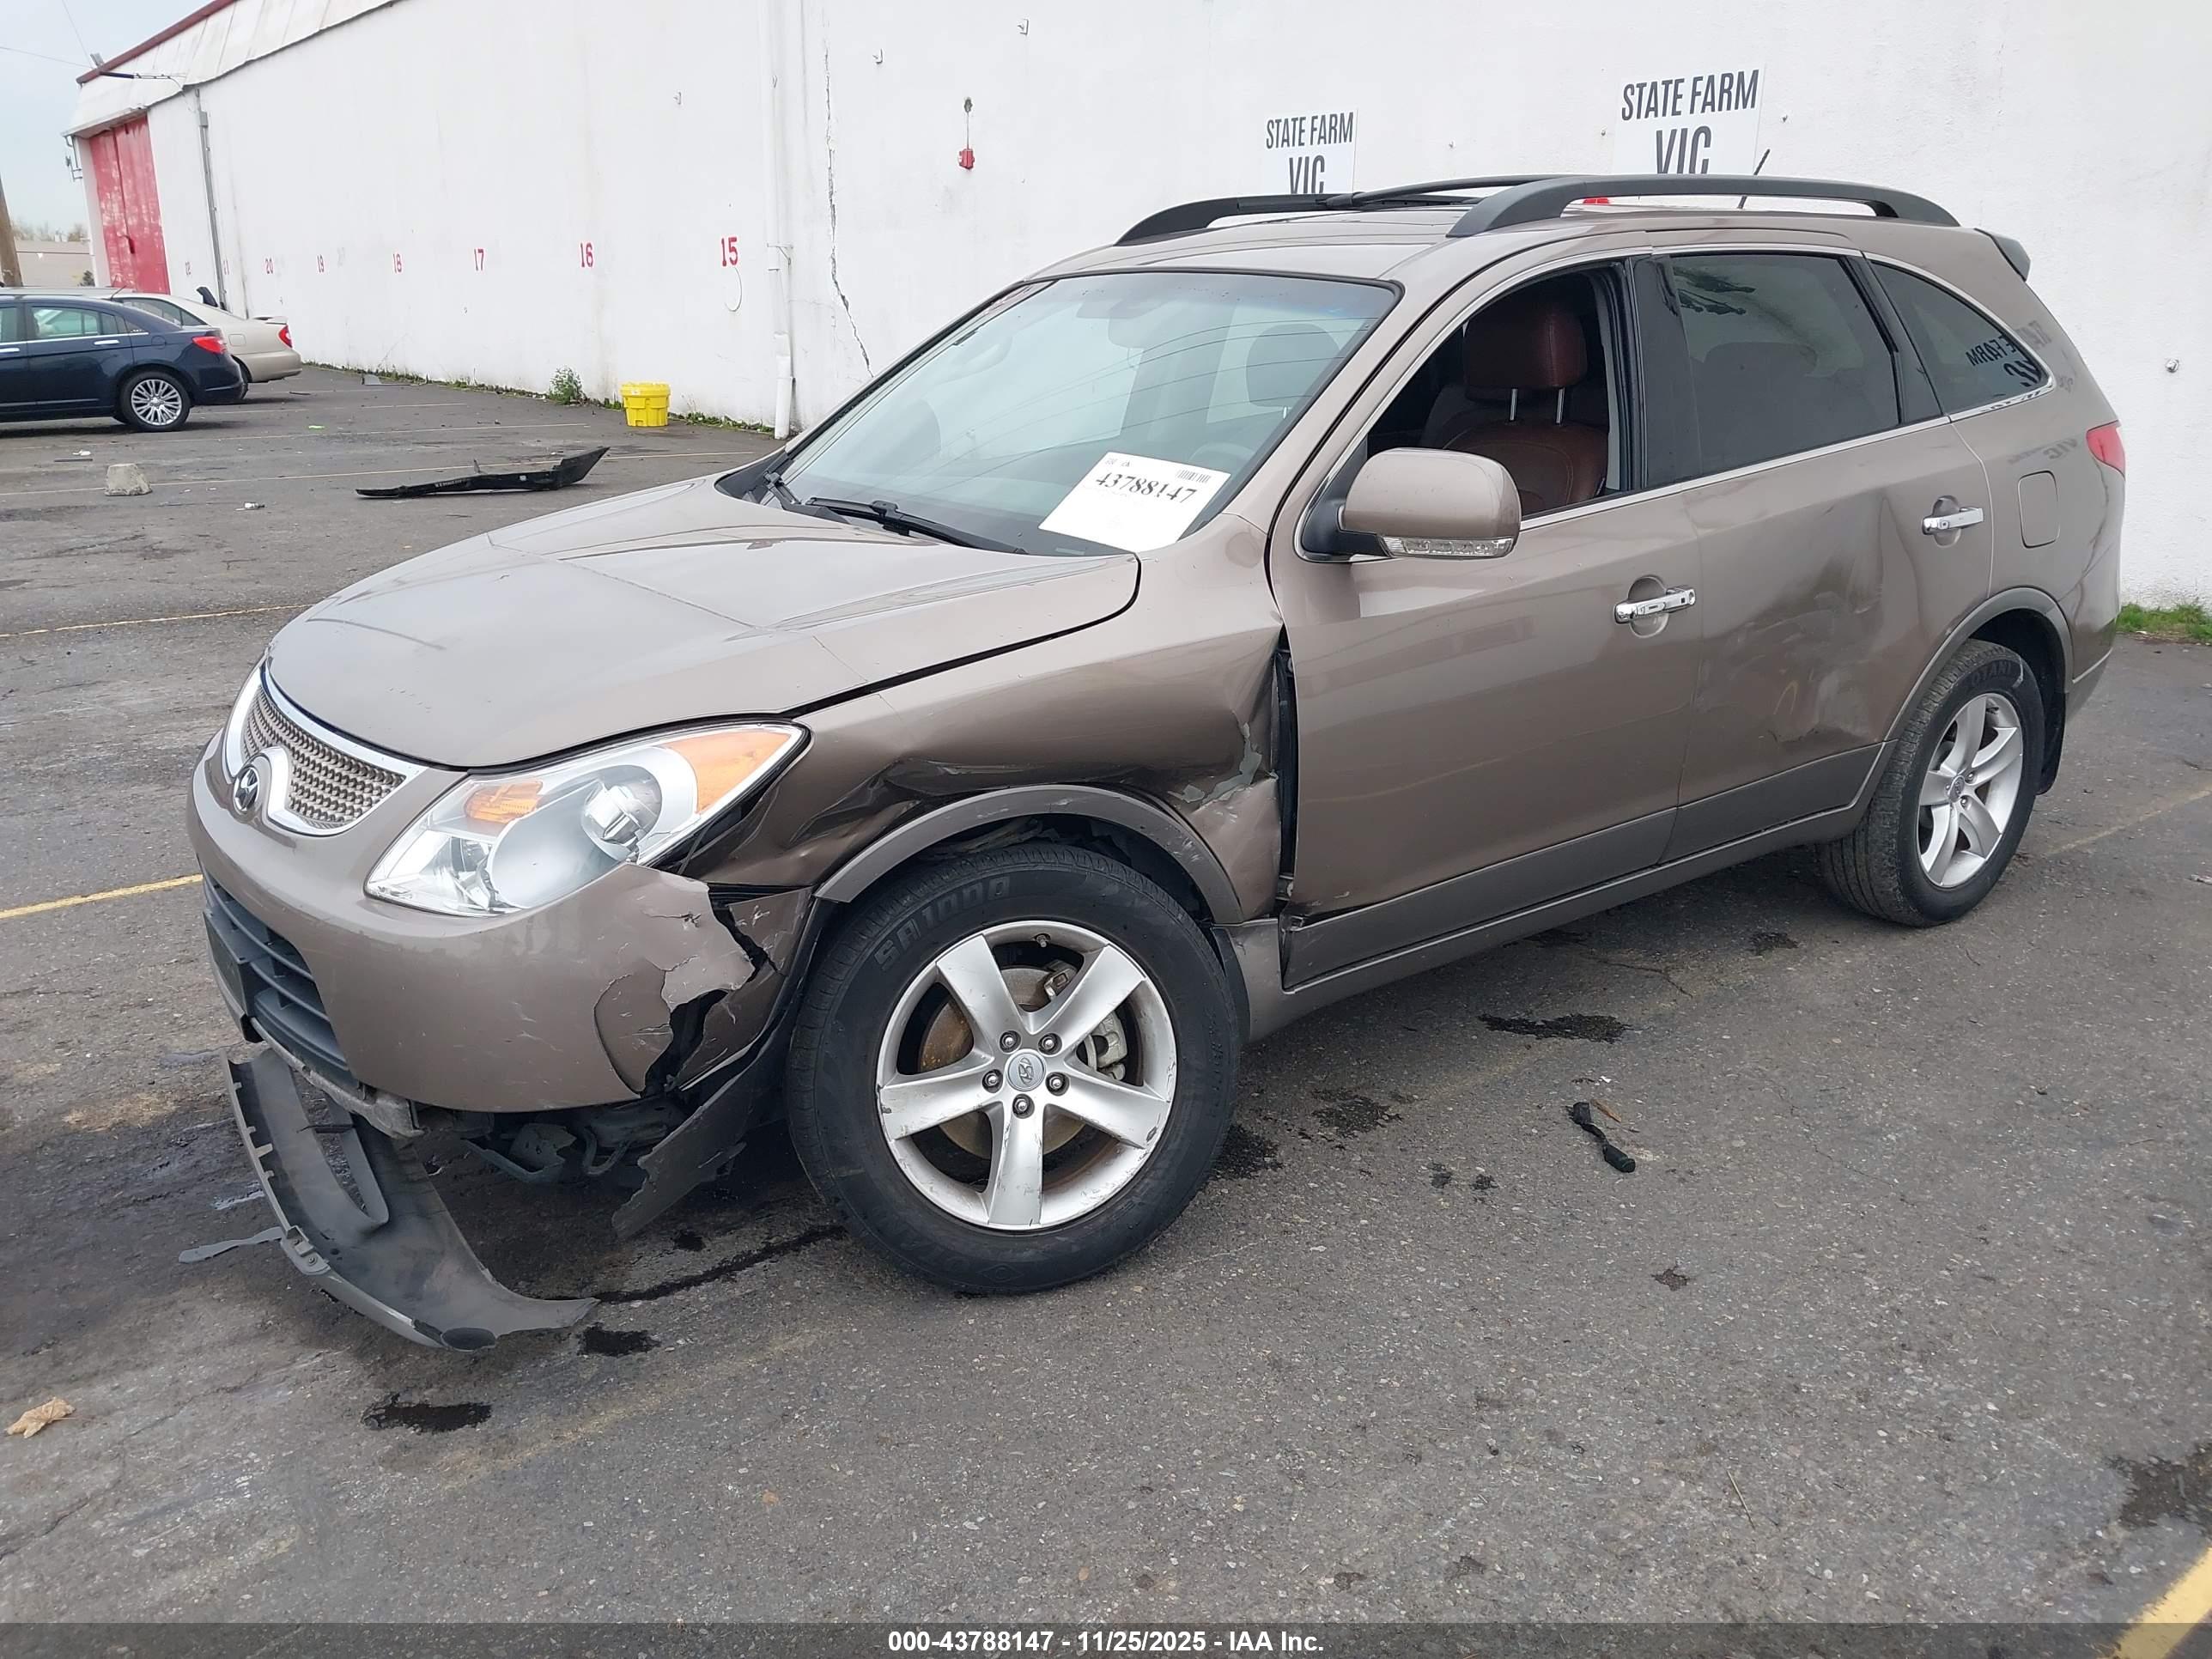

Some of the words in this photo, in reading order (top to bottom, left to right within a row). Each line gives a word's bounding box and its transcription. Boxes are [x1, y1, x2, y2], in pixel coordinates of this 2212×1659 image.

[1621, 78, 1685, 121] STATE
[1689, 69, 1759, 115] FARM
[1266, 116, 1306, 149] STATE
[1310, 112, 1354, 146] FARM
[1656, 125, 1711, 174] VIC
[1289, 155, 1325, 194] VIC
[264, 258, 274, 275] 20
[317, 254, 325, 273] 19
[392, 253, 402, 273] 18
[473, 248, 484, 271] 17
[580, 242, 593, 268] 16
[720, 236, 738, 267] 15
[1096, 472, 1198, 503] 43788147
[873, 876, 1011, 972] SA1000
